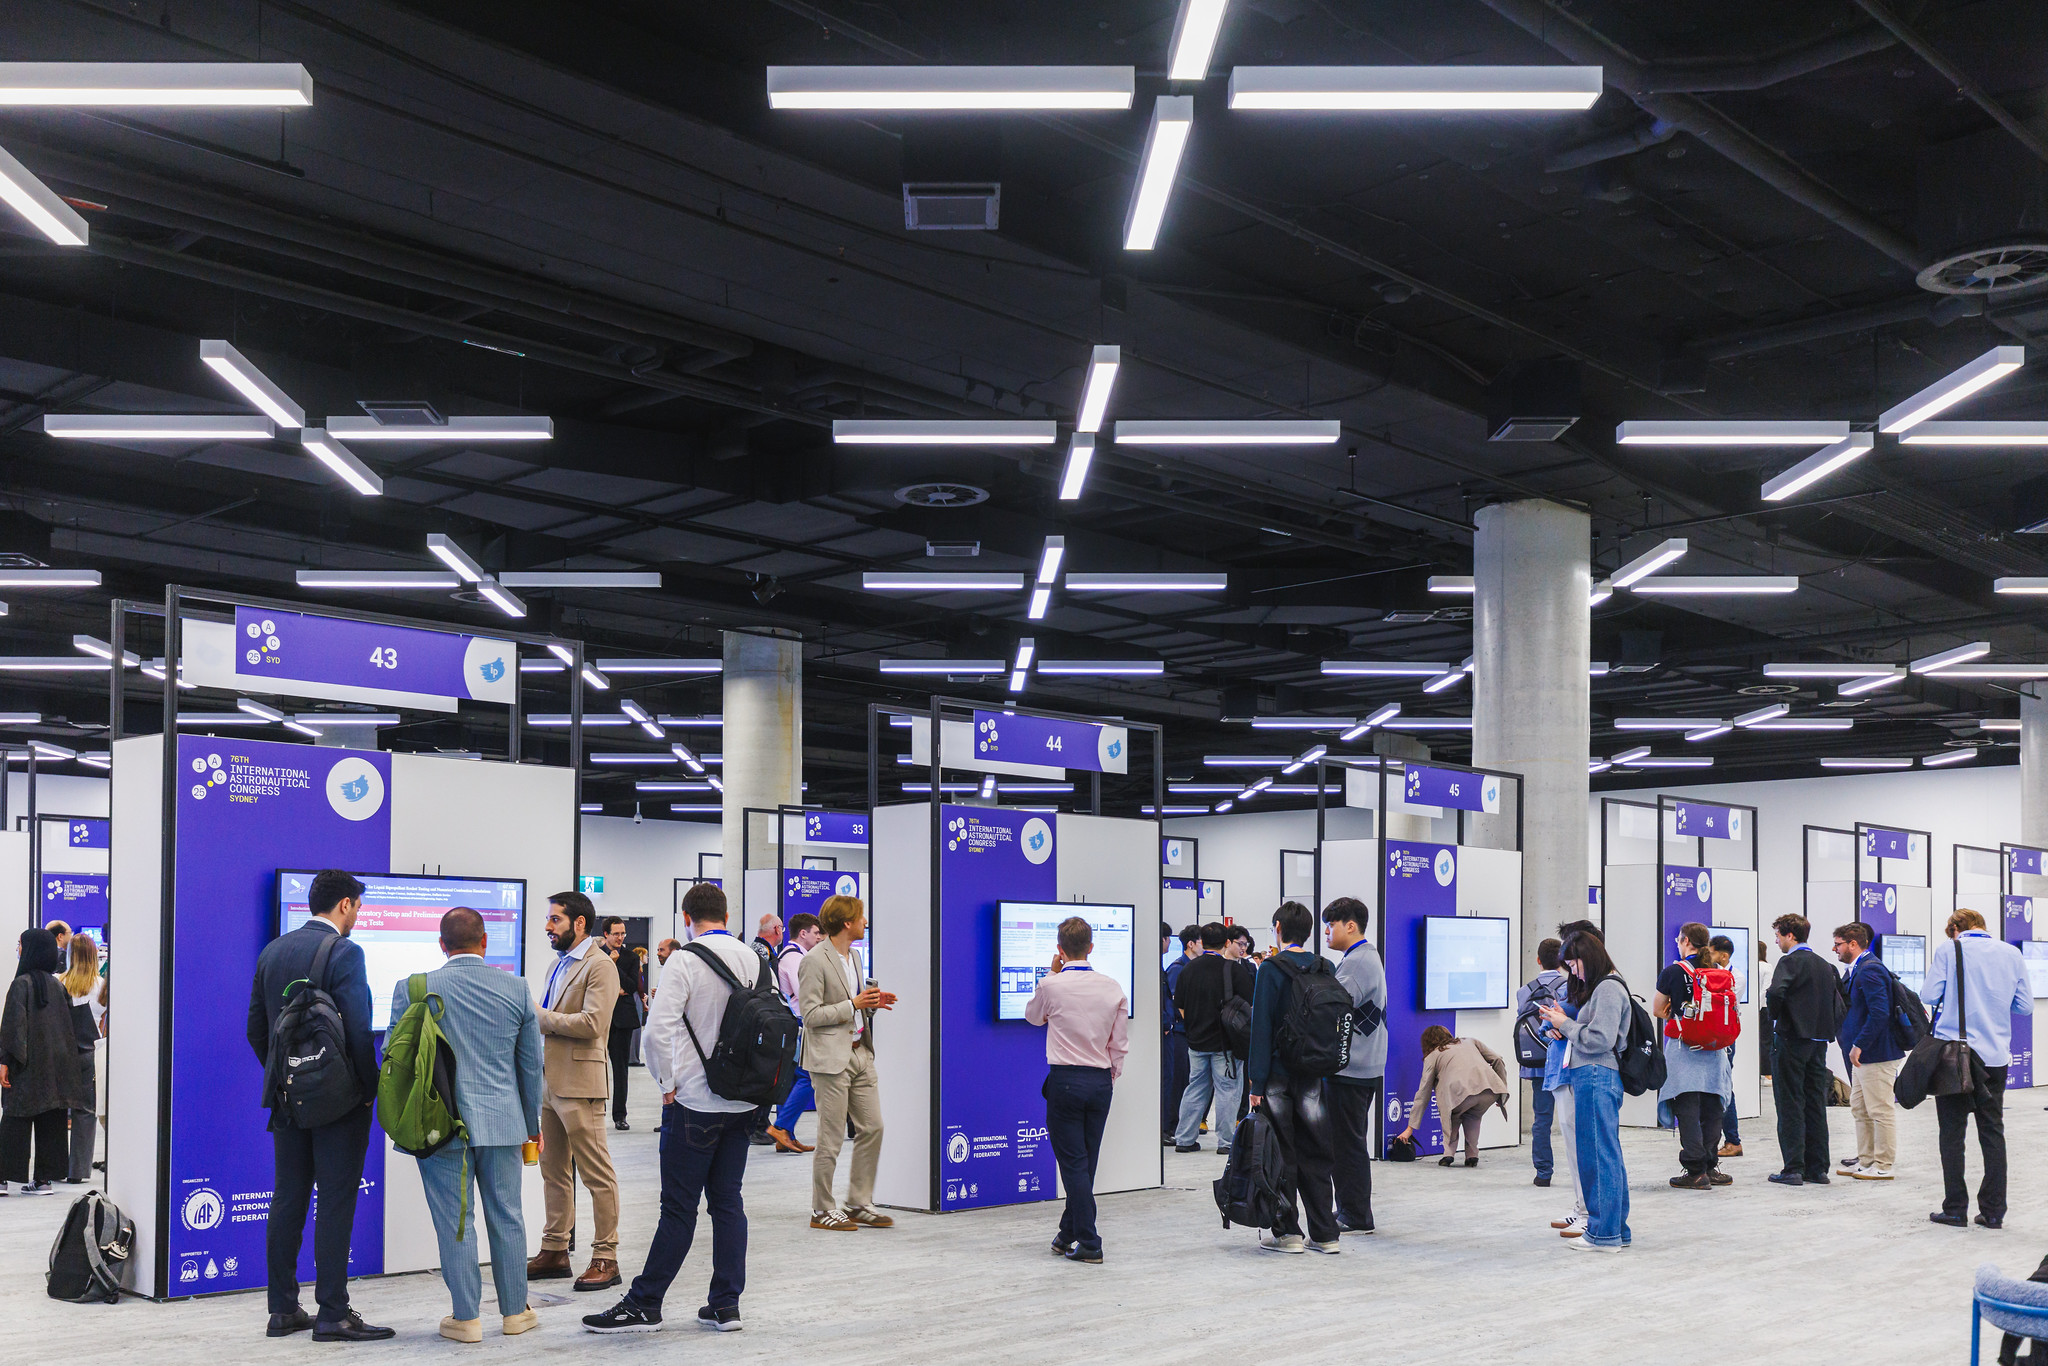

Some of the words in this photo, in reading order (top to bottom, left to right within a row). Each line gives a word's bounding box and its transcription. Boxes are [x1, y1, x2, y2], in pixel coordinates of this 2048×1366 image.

[266, 623, 272, 631] A
[270, 639, 276, 648] C
[249, 652, 259, 662] 25
[266, 656, 281, 664] SYD
[370, 647, 398, 669] 43
[1046, 735, 1062, 752] 44
[212, 757, 218, 765] A
[230, 755, 249, 764] 76TH
[230, 764, 310, 779] INTERNATIONAL
[217, 773, 223, 782] C
[230, 775, 310, 789] ASTRONAUTICAL
[194, 788, 205, 797] 25
[229, 784, 280, 796] CONGRESS
[1449, 784, 1460, 796] 45
[229, 795, 259, 803] SYDNEY
[1706, 817, 1714, 827] 46
[852, 824, 863, 835] 33
[969, 825, 1012, 834] INTERNATIONAL
[969, 832, 1012, 841] ASTRONAUTICAL
[969, 839, 996, 847] CONGRESS
[232, 1192, 274, 1201] INTERNATI
[232, 1202, 271, 1212] ASTRONA
[194, 1202, 214, 1224] IAF
[232, 1213, 269, 1222] FEDERATI
